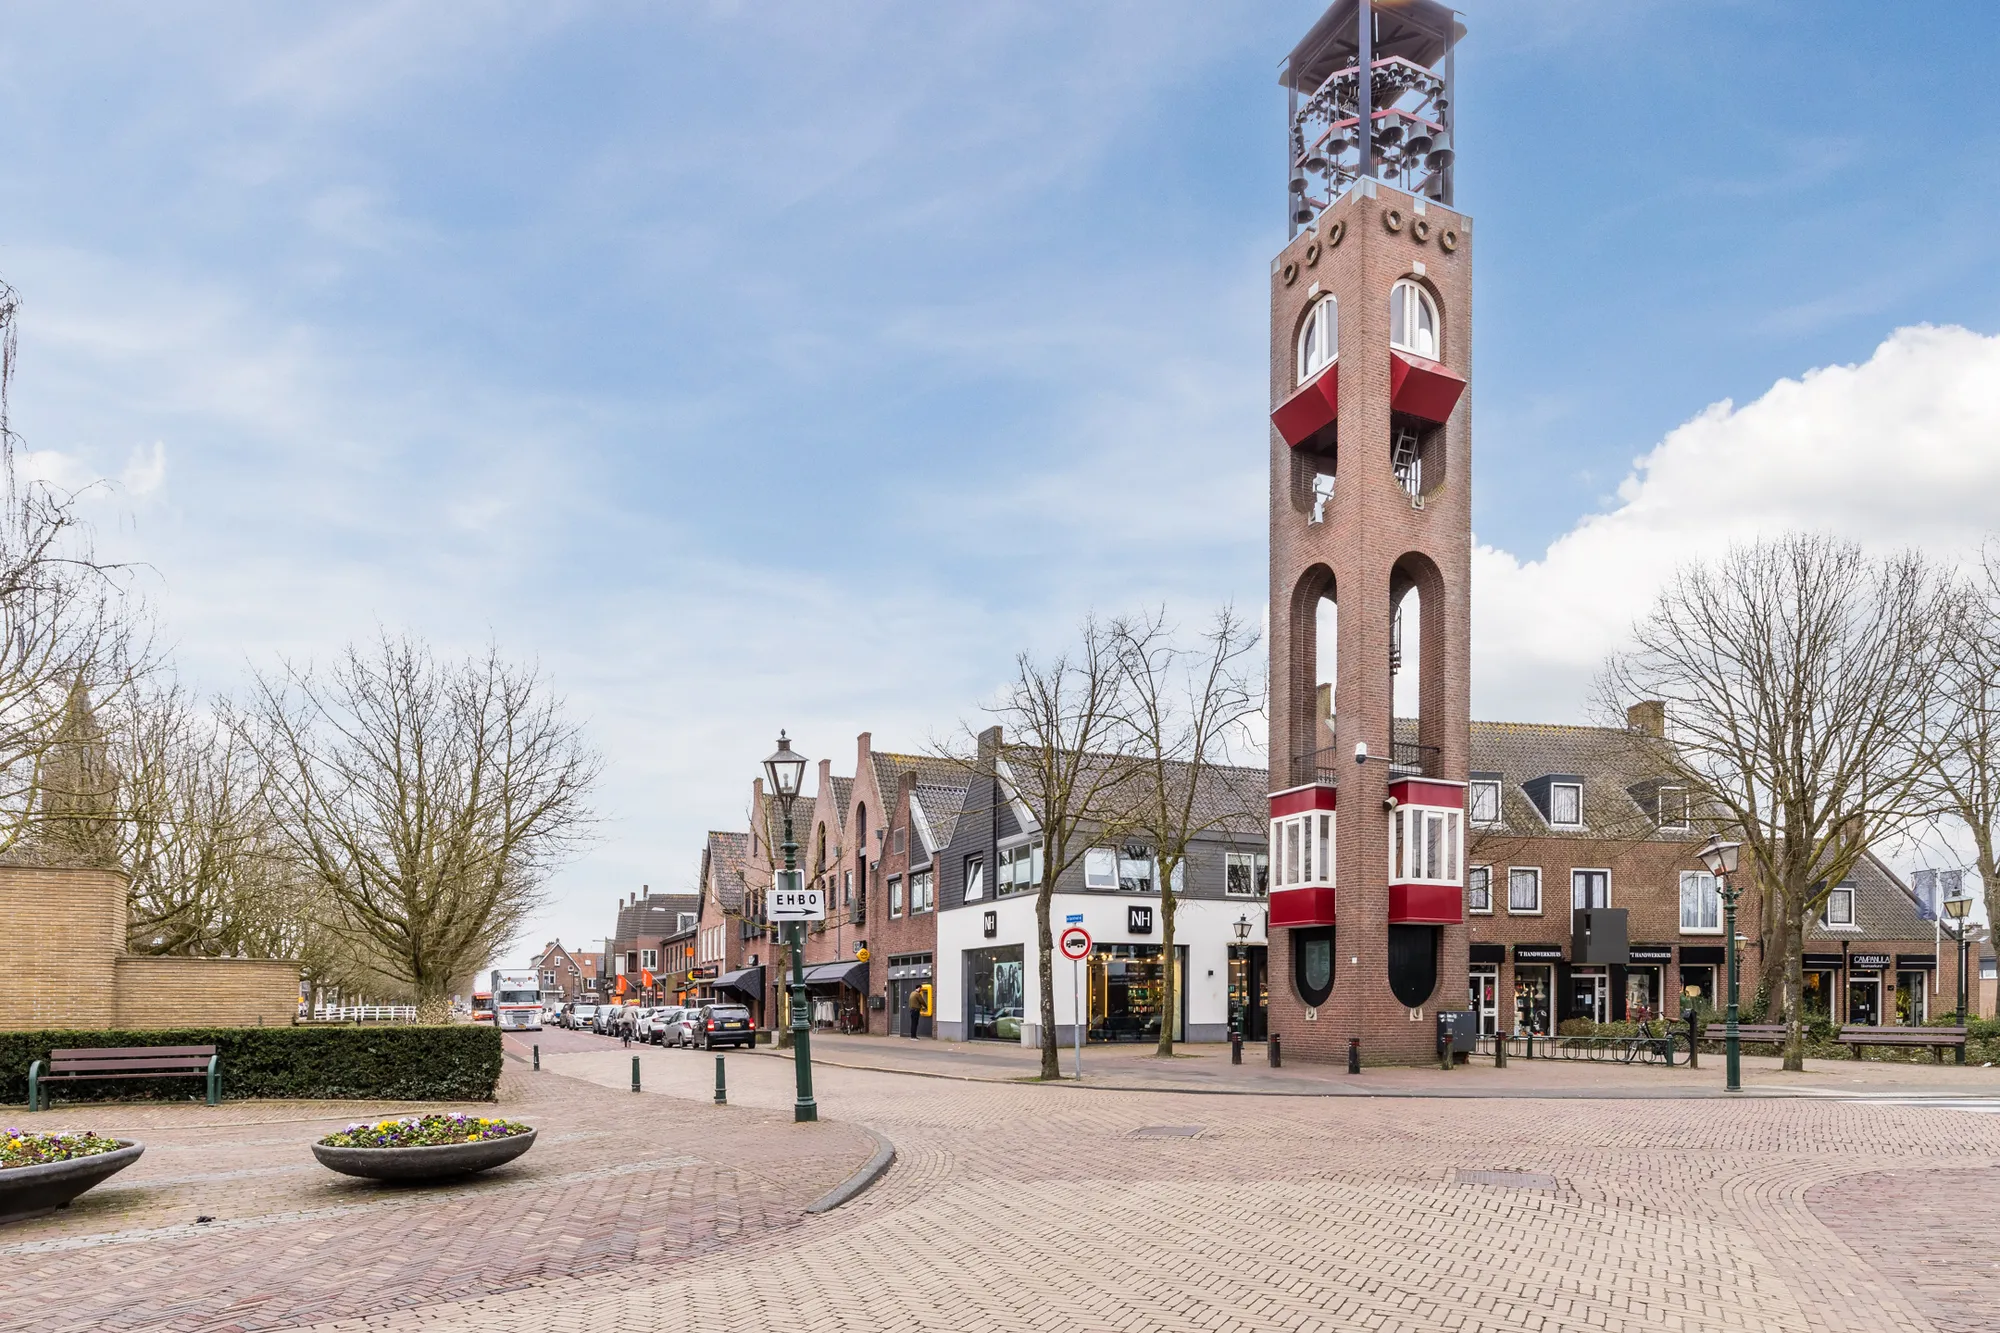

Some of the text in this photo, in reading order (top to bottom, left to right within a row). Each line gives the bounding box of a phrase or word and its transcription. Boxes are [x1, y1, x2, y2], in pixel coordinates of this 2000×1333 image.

[776, 894, 816, 905] EHBO
[984, 915, 995, 931] NH
[1131, 910, 1150, 927] NH
